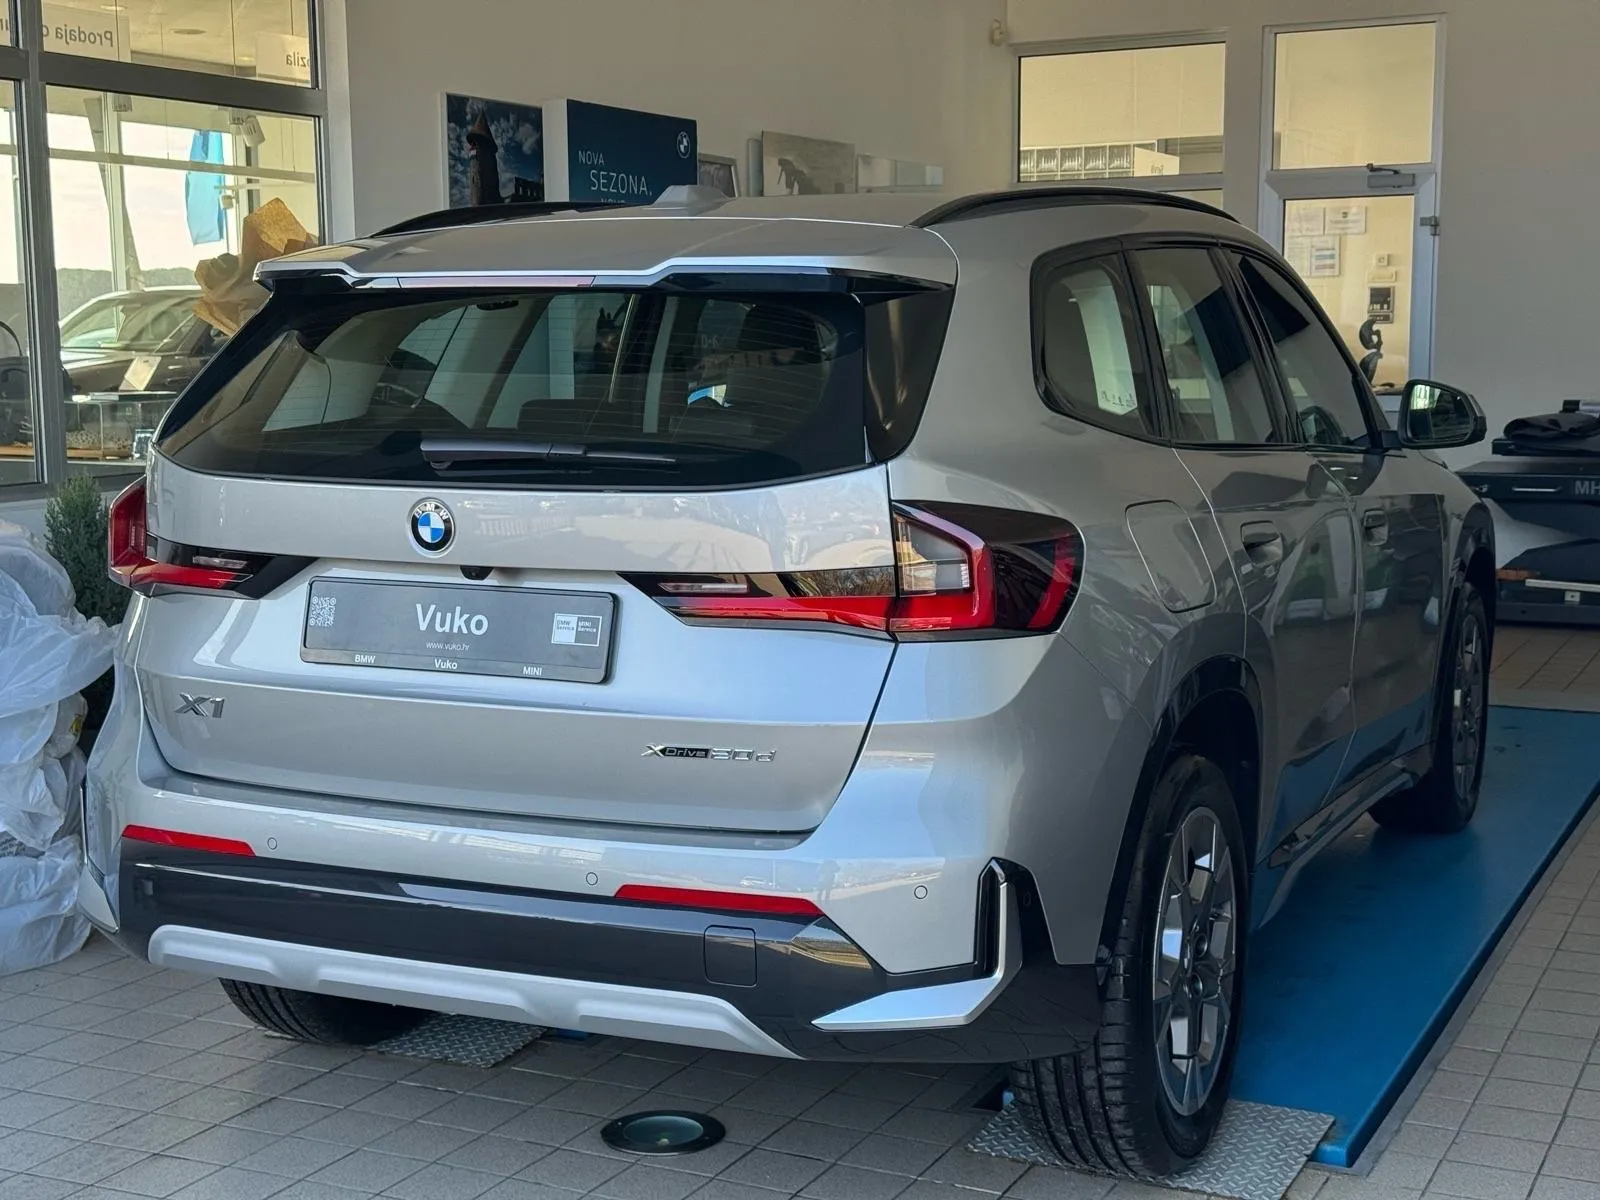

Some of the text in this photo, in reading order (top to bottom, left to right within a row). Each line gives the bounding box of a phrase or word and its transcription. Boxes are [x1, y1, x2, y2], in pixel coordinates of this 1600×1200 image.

[578, 150, 605, 165] NOVA
[590, 169, 653, 196] SEZONA.
[414, 503, 449, 520] BMW
[416, 603, 489, 636] Vuko
[426, 641, 470, 651] www.vuko.hr
[354, 654, 376, 664] BMW
[434, 658, 458, 670] Vuko
[522, 666, 542, 677] MINI
[175, 692, 226, 719] X1
